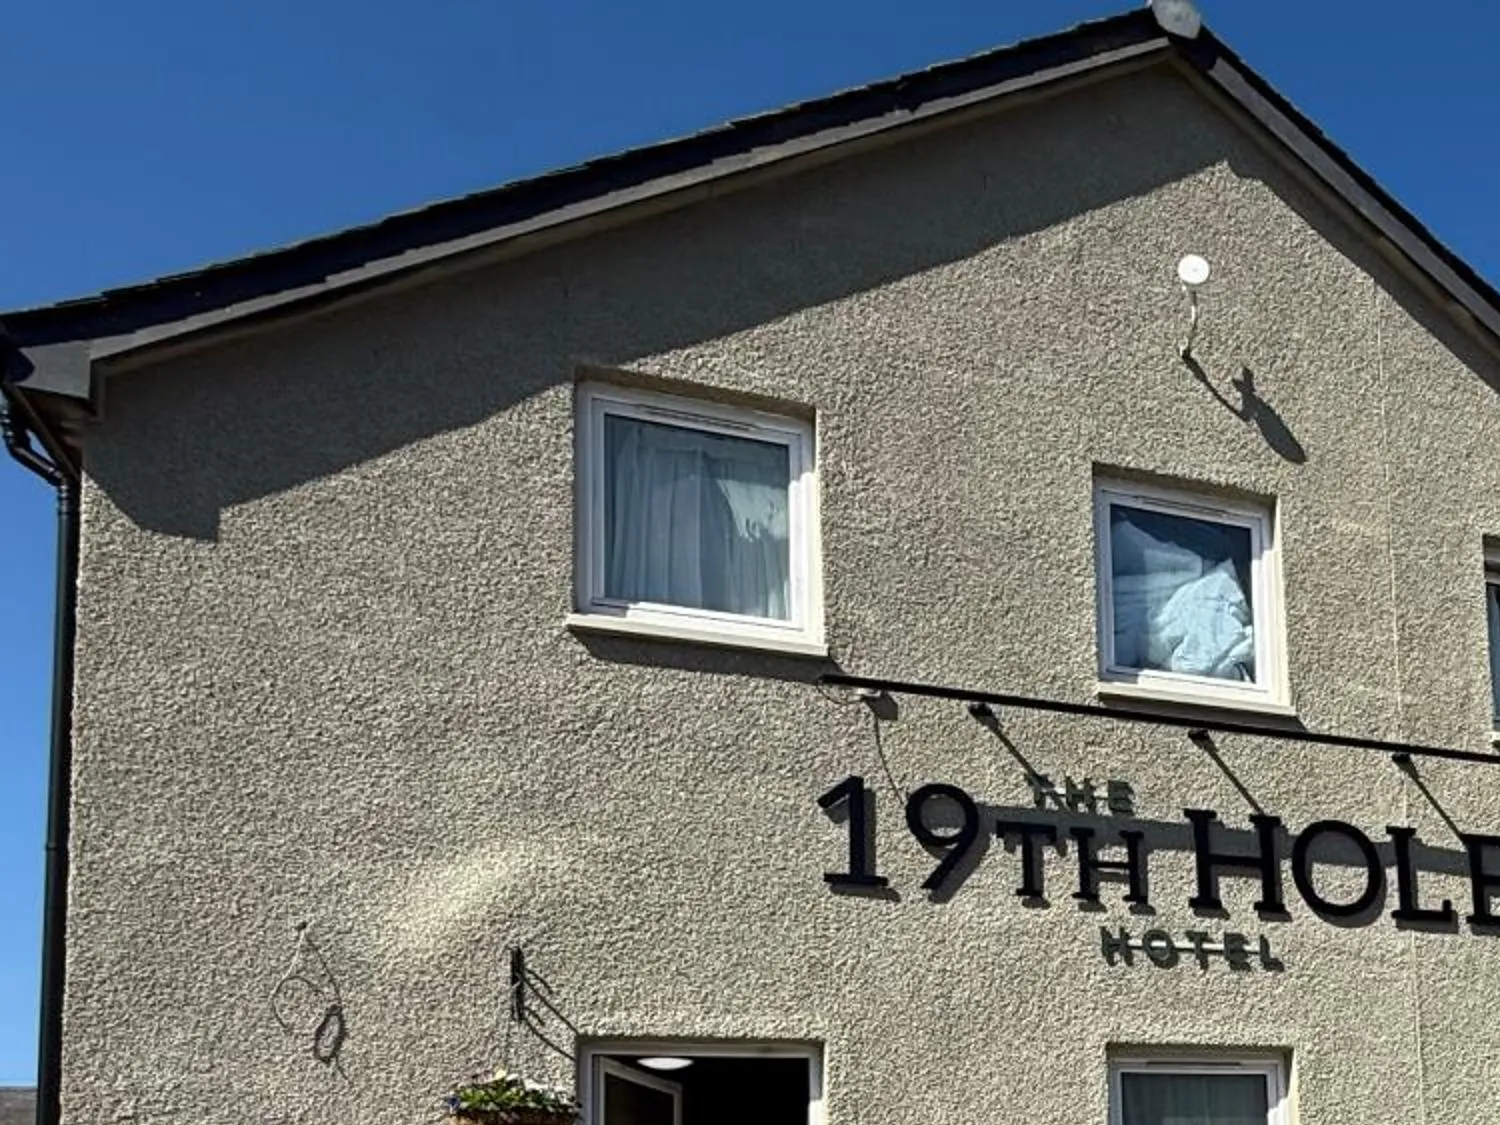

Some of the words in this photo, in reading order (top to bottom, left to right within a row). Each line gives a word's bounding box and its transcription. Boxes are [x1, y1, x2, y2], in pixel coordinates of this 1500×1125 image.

[1027, 774, 1133, 814] THE
[818, 775, 1149, 903] 19TH
[1101, 926, 1284, 971] HOTEL
